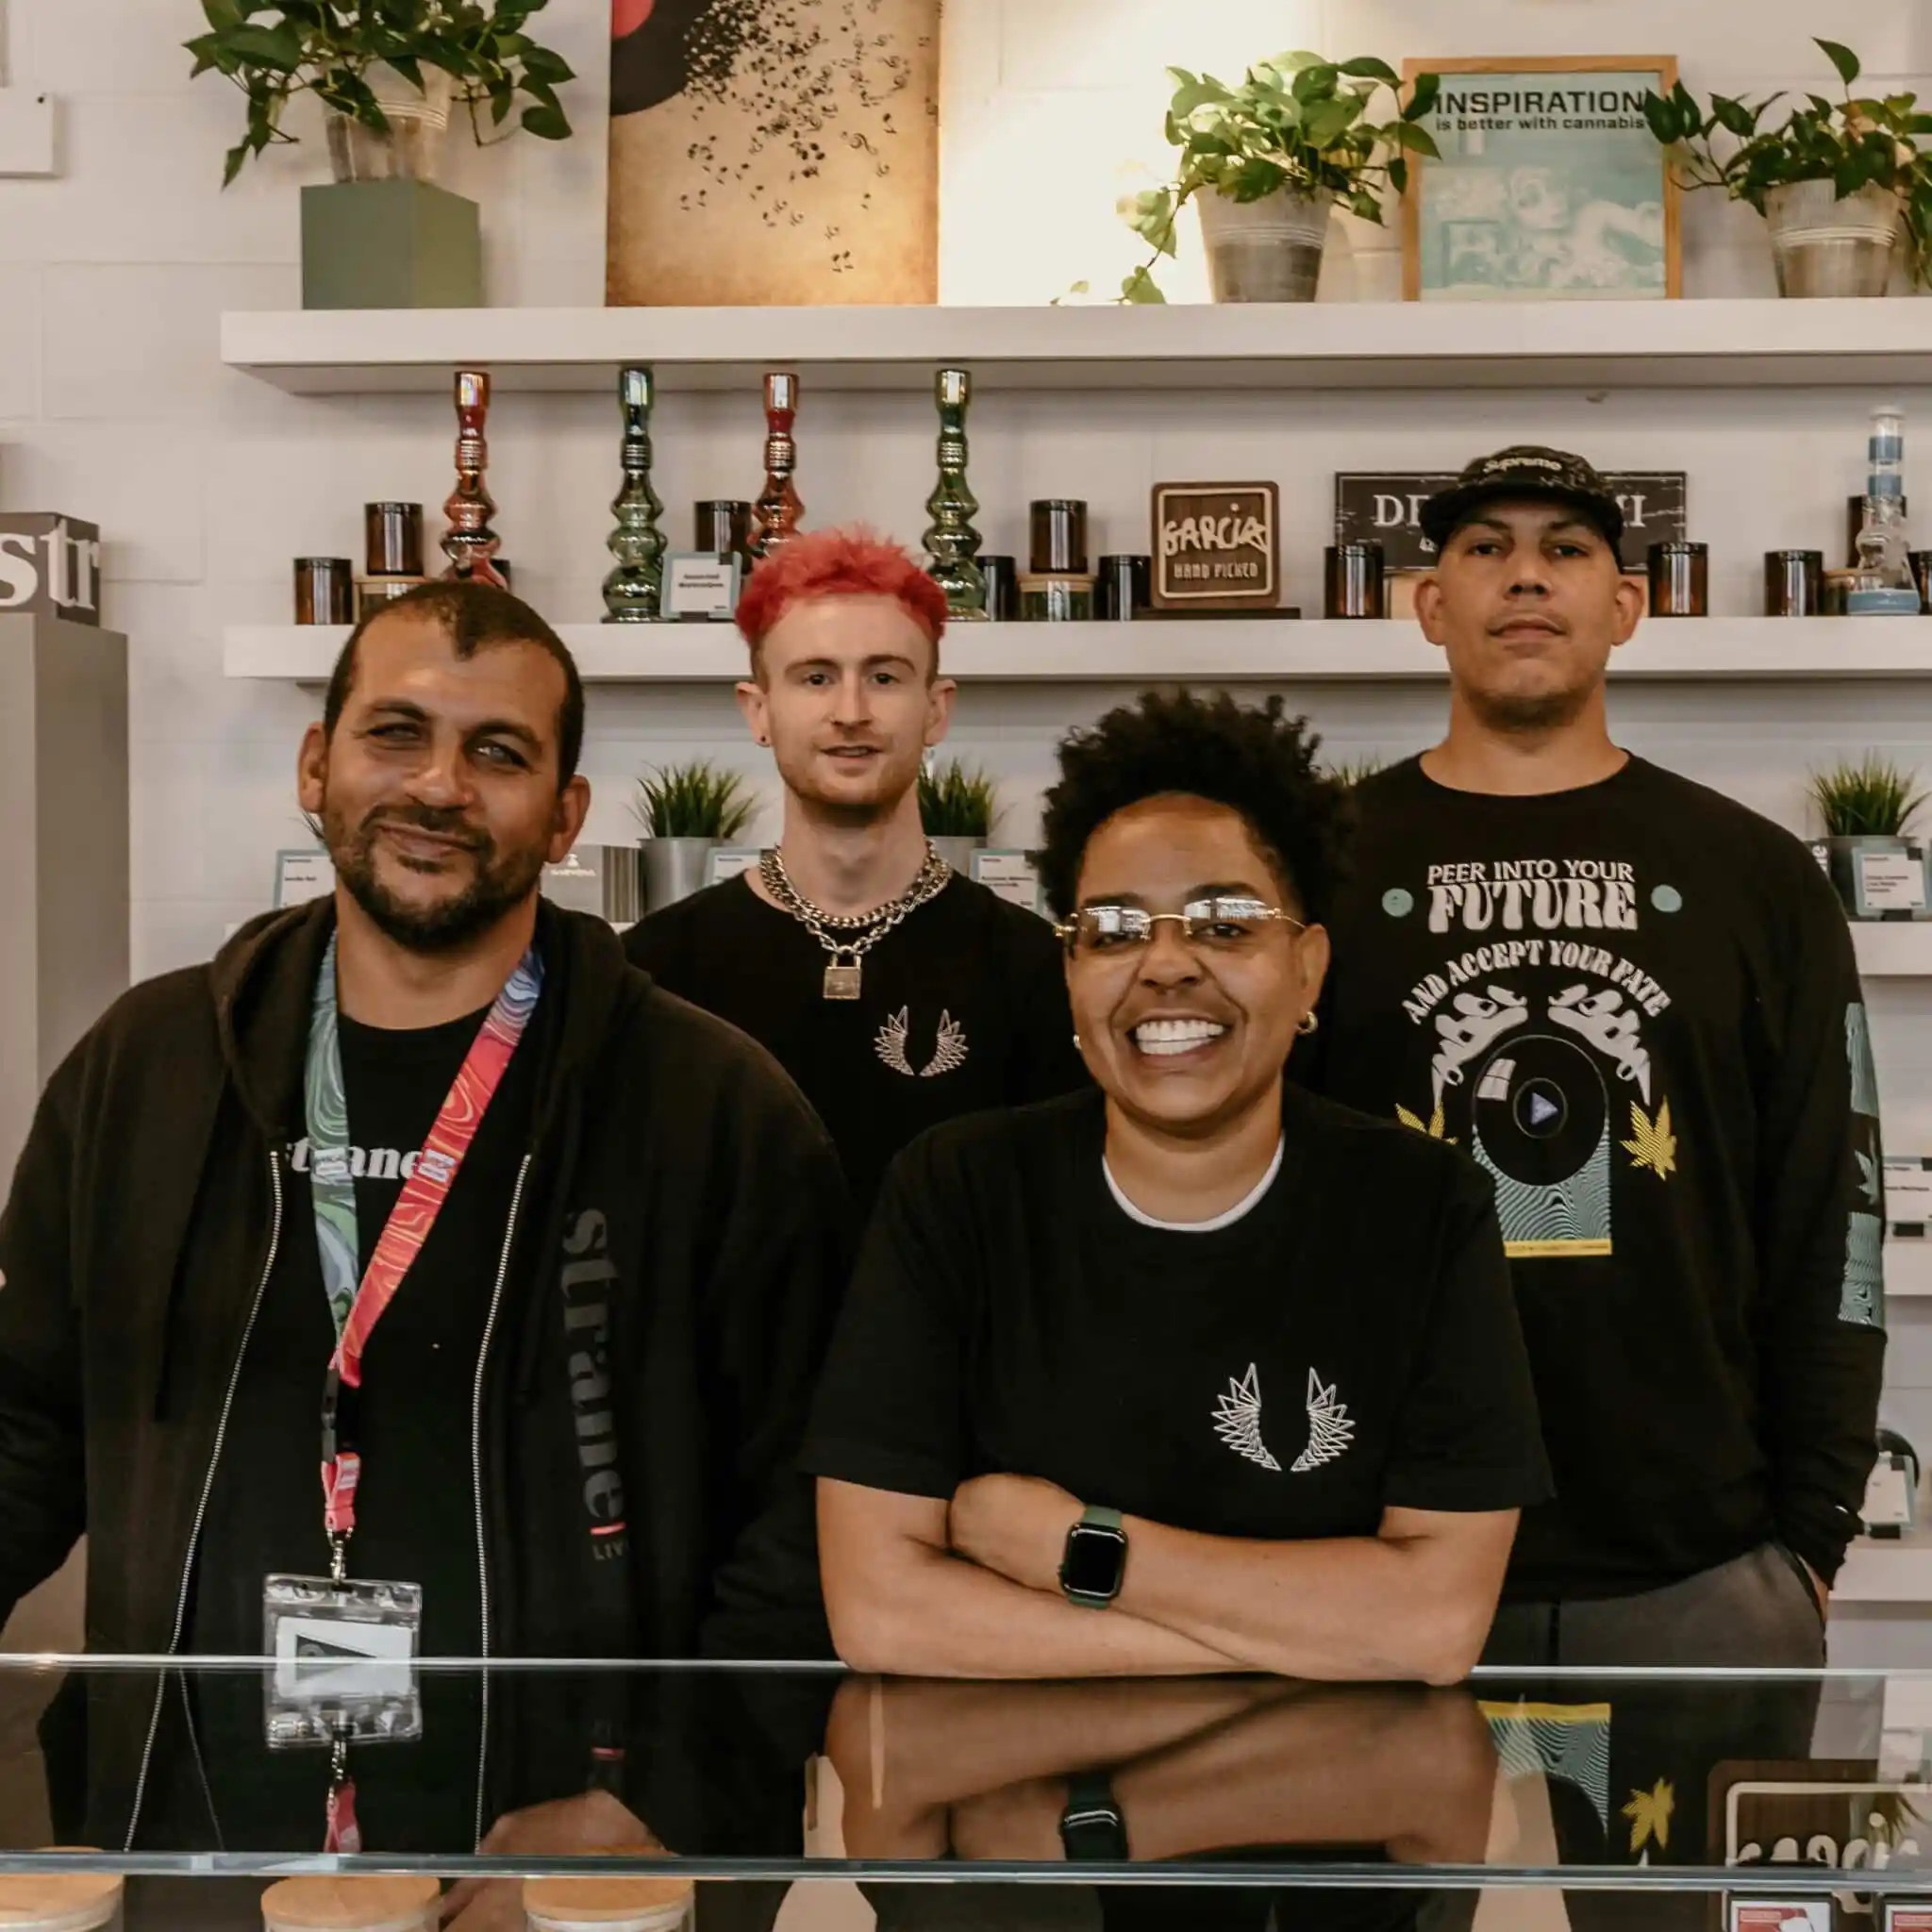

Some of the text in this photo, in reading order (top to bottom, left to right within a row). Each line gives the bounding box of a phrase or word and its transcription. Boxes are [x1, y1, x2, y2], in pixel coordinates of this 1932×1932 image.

[1435, 90, 1644, 114] INSPIRATION
[1435, 116, 1645, 131] is better with cannabis
[1426, 859, 1636, 885] PEER INTO YOUR
[1425, 878, 1639, 934] FUTURE
[1402, 939, 1672, 1025] AND ACCEPT YOUR FATE
